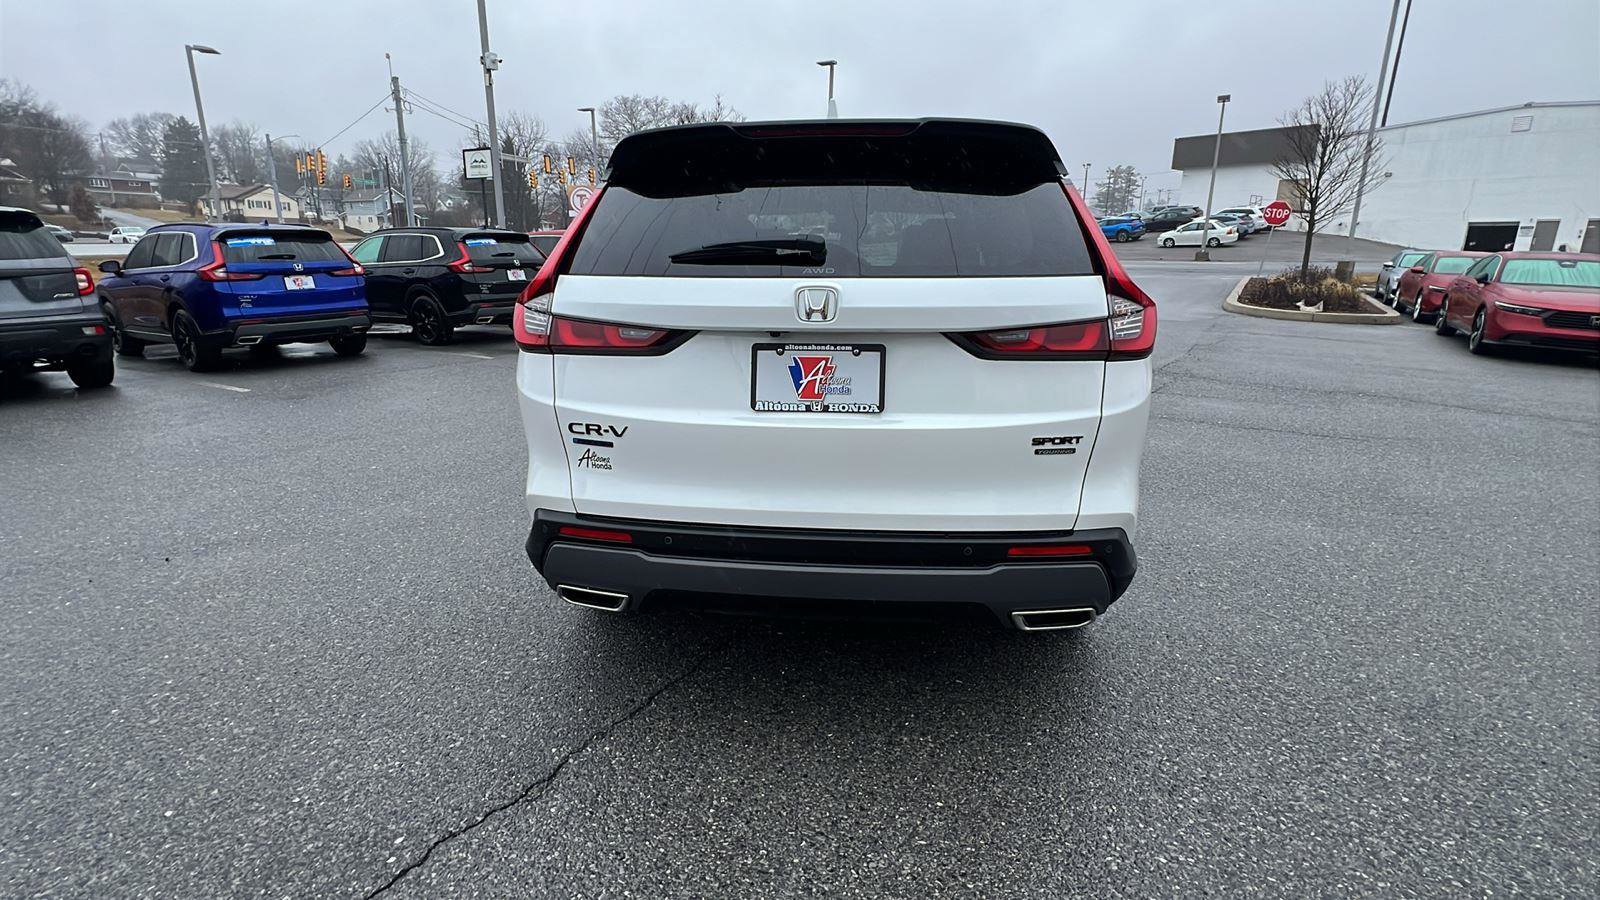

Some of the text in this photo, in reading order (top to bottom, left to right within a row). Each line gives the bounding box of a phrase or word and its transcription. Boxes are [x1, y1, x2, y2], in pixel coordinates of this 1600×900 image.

[1264, 208, 1290, 219] STOP
[819, 385, 851, 395] Honda
[755, 401, 806, 411] Altoona
[828, 403, 880, 413] HONDA
[568, 422, 628, 437] CR-V
[1031, 436, 1083, 446] SPORT
[591, 461, 613, 470] Honda
